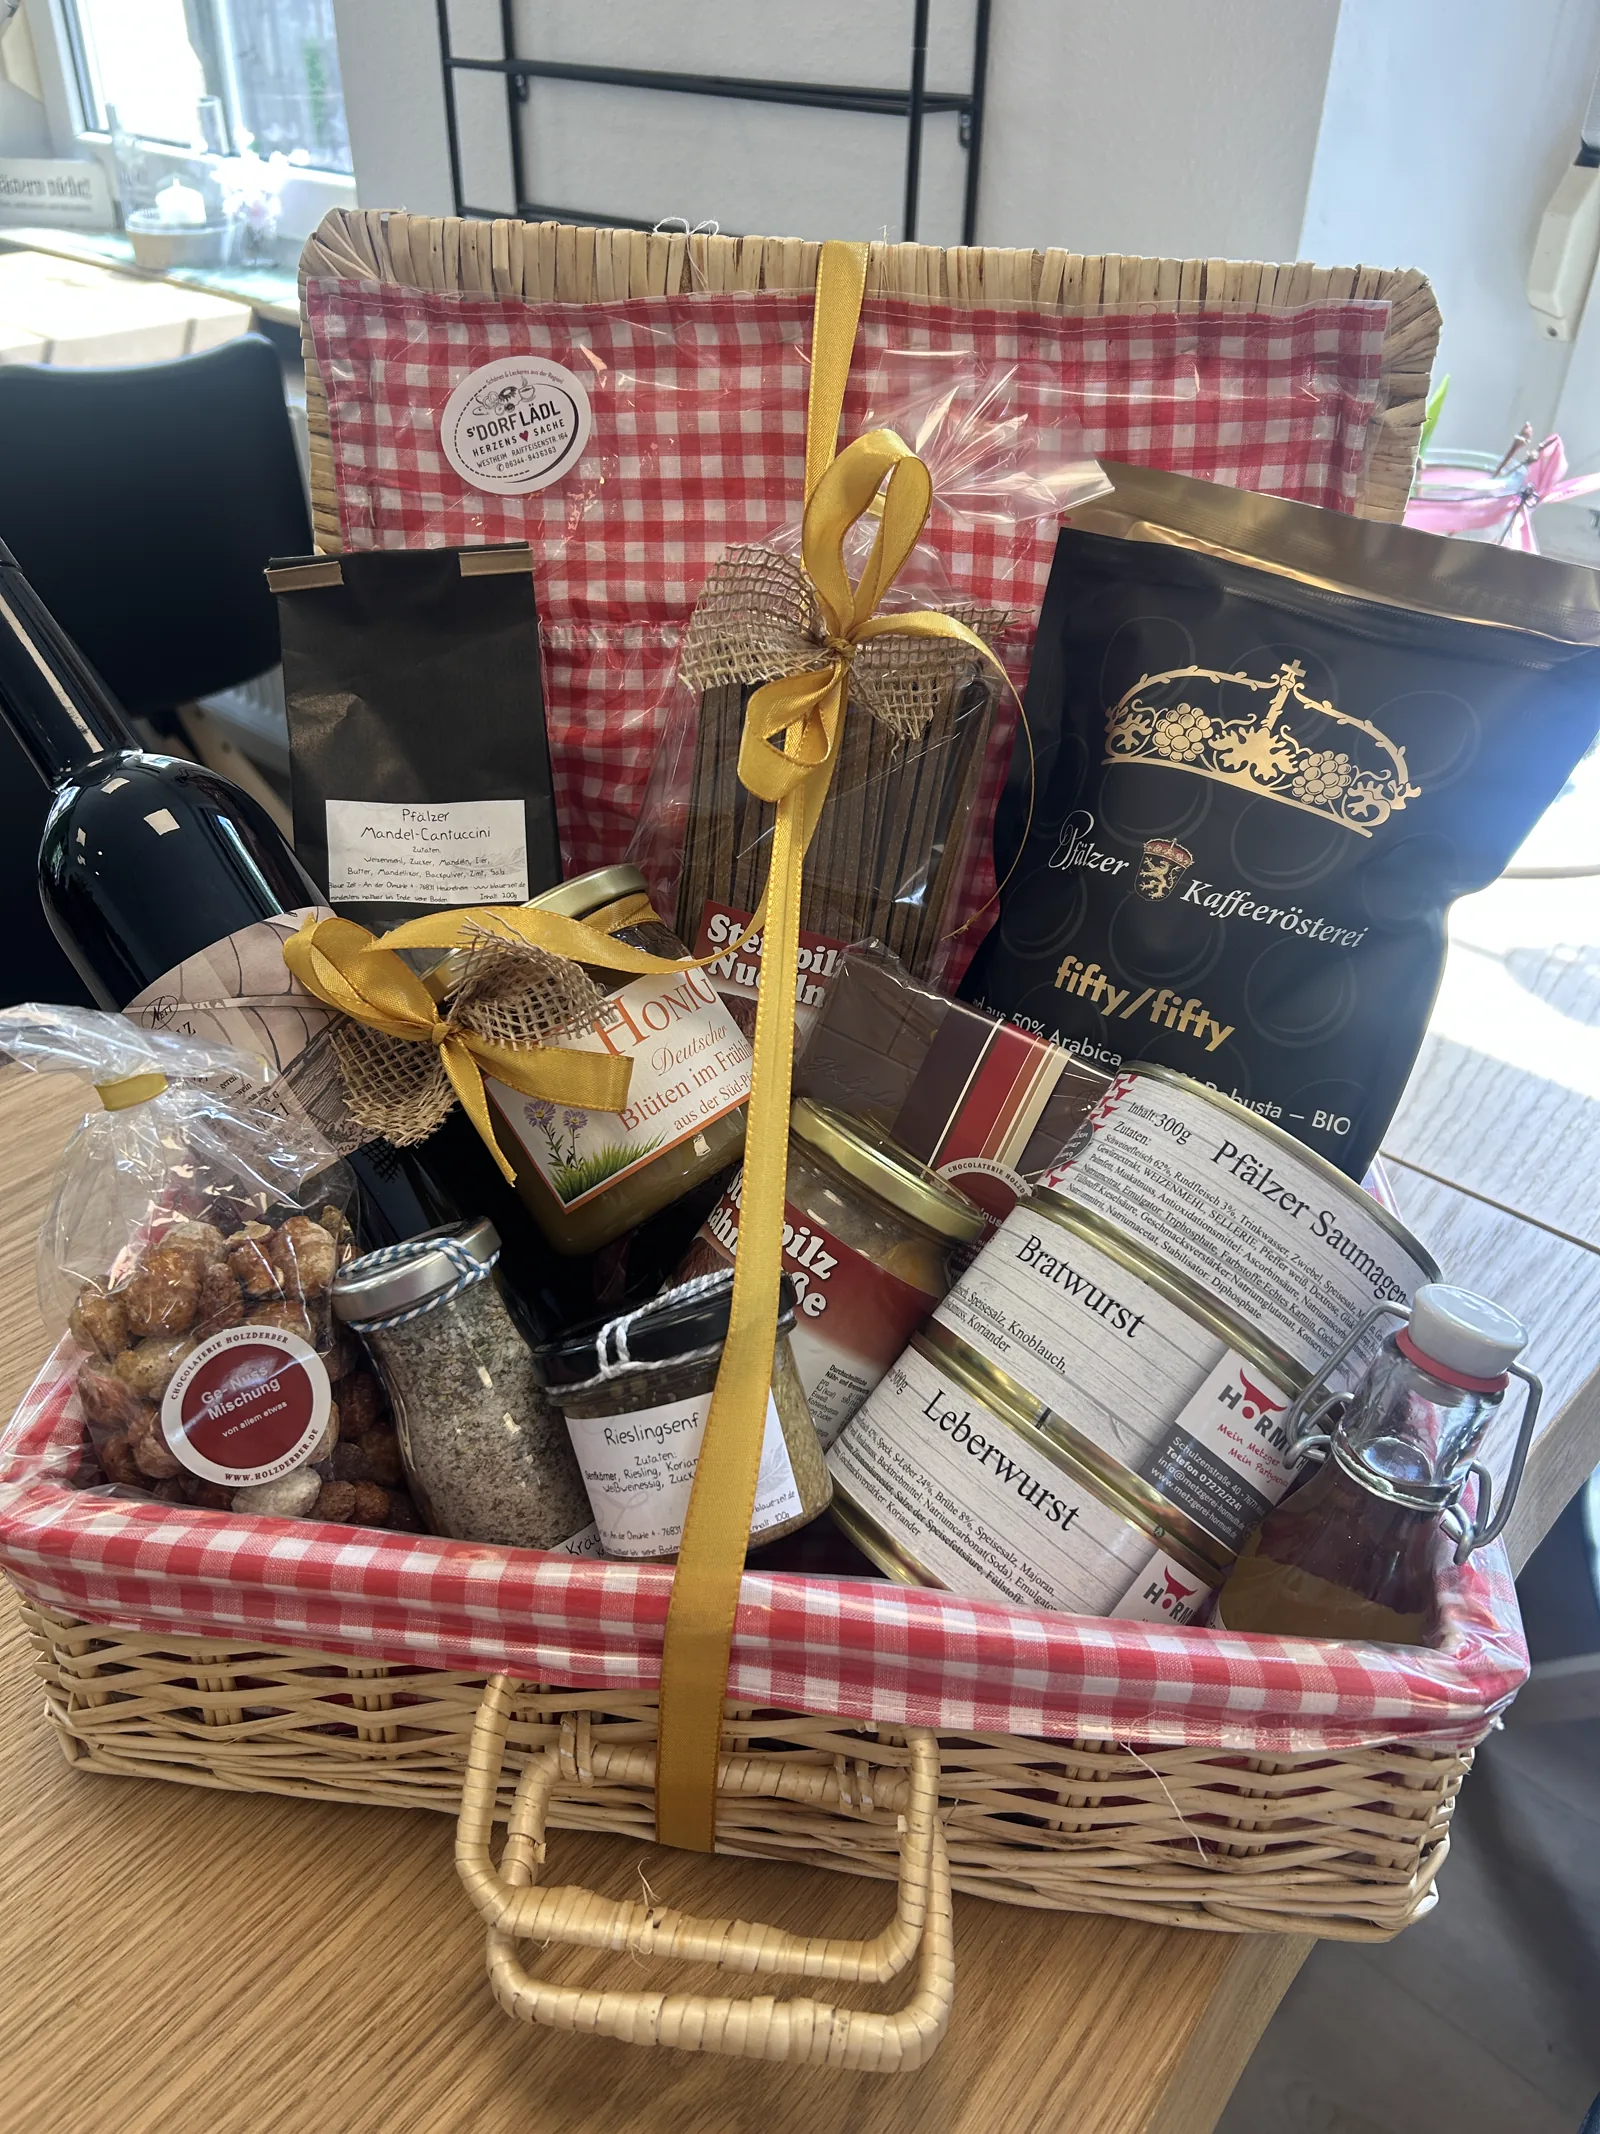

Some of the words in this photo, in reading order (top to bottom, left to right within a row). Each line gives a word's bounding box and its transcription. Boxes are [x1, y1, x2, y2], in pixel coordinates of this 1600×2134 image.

[472, 435, 518, 457] HERZENS
[534, 418, 565, 436] SACHE
[476, 452, 508, 468] WESTHEIM
[558, 432, 568, 442] 164
[360, 826, 491, 842] Mandel-Cantuccini
[402, 808, 450, 822] Pfälzer
[348, 867, 373, 876] Butter,
[426, 870, 466, 880] Backpulver,
[410, 858, 434, 866] Zucker,
[1048, 809, 1130, 876] Pfälzer
[1180, 879, 1370, 949] Kaffeerösterei
[651, 1020, 727, 1077] Deutscher
[1011, 1012, 1046, 1038] 50%
[1049, 1028, 1123, 1067] Arabica
[617, 1080, 692, 1132] Blüten
[688, 1065, 718, 1088] im
[674, 1110, 698, 1131] aus
[700, 1095, 720, 1114] der
[1114, 1120, 1152, 1146] Zutaten:
[1311, 1110, 1351, 1136] BIO
[948, 1162, 1004, 1176] CHOCOLATERIE
[1005, 1173, 1026, 1194] HOLZD
[1210, 1138, 1312, 1221] Pfälzer
[1096, 1144, 1141, 1174] Gewürzextrakt,
[1143, 1166, 1206, 1214] WEIZENMEHL,
[1208, 1208, 1258, 1251] SELLERIE,
[1260, 1244, 1288, 1272] Pfeffer
[1288, 1269, 1308, 1290] weiß,
[1308, 1284, 1340, 1317] Dextrose,
[1104, 1134, 1154, 1164] Schweinefleisch
[1154, 1160, 1172, 1177] 62%,
[1174, 1171, 1220, 1206] Rindfleisch
[1220, 1202, 1237, 1219] 3%,
[1240, 1214, 1290, 1258] Trinkwasser,
[1290, 1252, 1324, 1285] Zwiebel,
[1324, 1280, 1356, 1316] Speisesalz,
[1114, 1166, 1156, 1198] Muskatnuss,
[1158, 1192, 1244, 1254] Antioxidationsmittel:
[1243, 1251, 1300, 1301] Ascorbinsäure,
[1106, 1204, 1160, 1246] Natriumacetat,
[1160, 1240, 1212, 1280] Stabilisator:
[1210, 1276, 1262, 1320] Diphosphate
[1122, 1185, 1165, 1214] Emulgator:
[1164, 1210, 1218, 1256] Triphosphate,
[1289, 1302, 1316, 1332] Karmin,
[1015, 1234, 1150, 1338] Bratwurst
[967, 1314, 1012, 1353] Koriander
[968, 1292, 1006, 1328] Speisesalz,
[1008, 1320, 1066, 1375] Knoblauch,
[172, 1340, 222, 1400] CHOCOLATERIE
[226, 1332, 289, 1345] HOLZDERBER
[230, 1366, 268, 1392] Nuss
[208, 1378, 281, 1420] Mischung
[222, 1424, 239, 1438] von
[240, 1412, 263, 1429] allem
[263, 1400, 288, 1418] etwas
[603, 1412, 700, 1448] Rieslingsenf
[1216, 1423, 1244, 1446] Mein
[1247, 1443, 1281, 1468] Metzger
[225, 1429, 319, 1482] WWW.HOLZDERBER.DE
[624, 1466, 661, 1480] Riesling,
[666, 1458, 700, 1472] Korian
[922, 1388, 1080, 1532] Leberwurst
[1166, 1446, 1198, 1477] Telefon
[1172, 1436, 1232, 1489] Schulzenstraße
[1230, 1484, 1242, 1496] 40
[1228, 1448, 1252, 1466] Mein
[668, 1472, 695, 1484] Zuck
[877, 1454, 924, 1502] Backtriebmittel:
[877, 1436, 892, 1460] Speck,
[892, 1452, 918, 1479] S-Leber
[916, 1474, 934, 1496] 24%,
[934, 1490, 959, 1516] Brühe
[958, 1511, 974, 1530] 8%,
[974, 1526, 1018, 1568] Speisesalz,
[1020, 1562, 1056, 1598] Majoran,
[885, 1500, 922, 1536] Koriander
[894, 1490, 914, 1514] Salze
[912, 1508, 926, 1524] der
[925, 1519, 984, 1575] Speisefettsäure,
